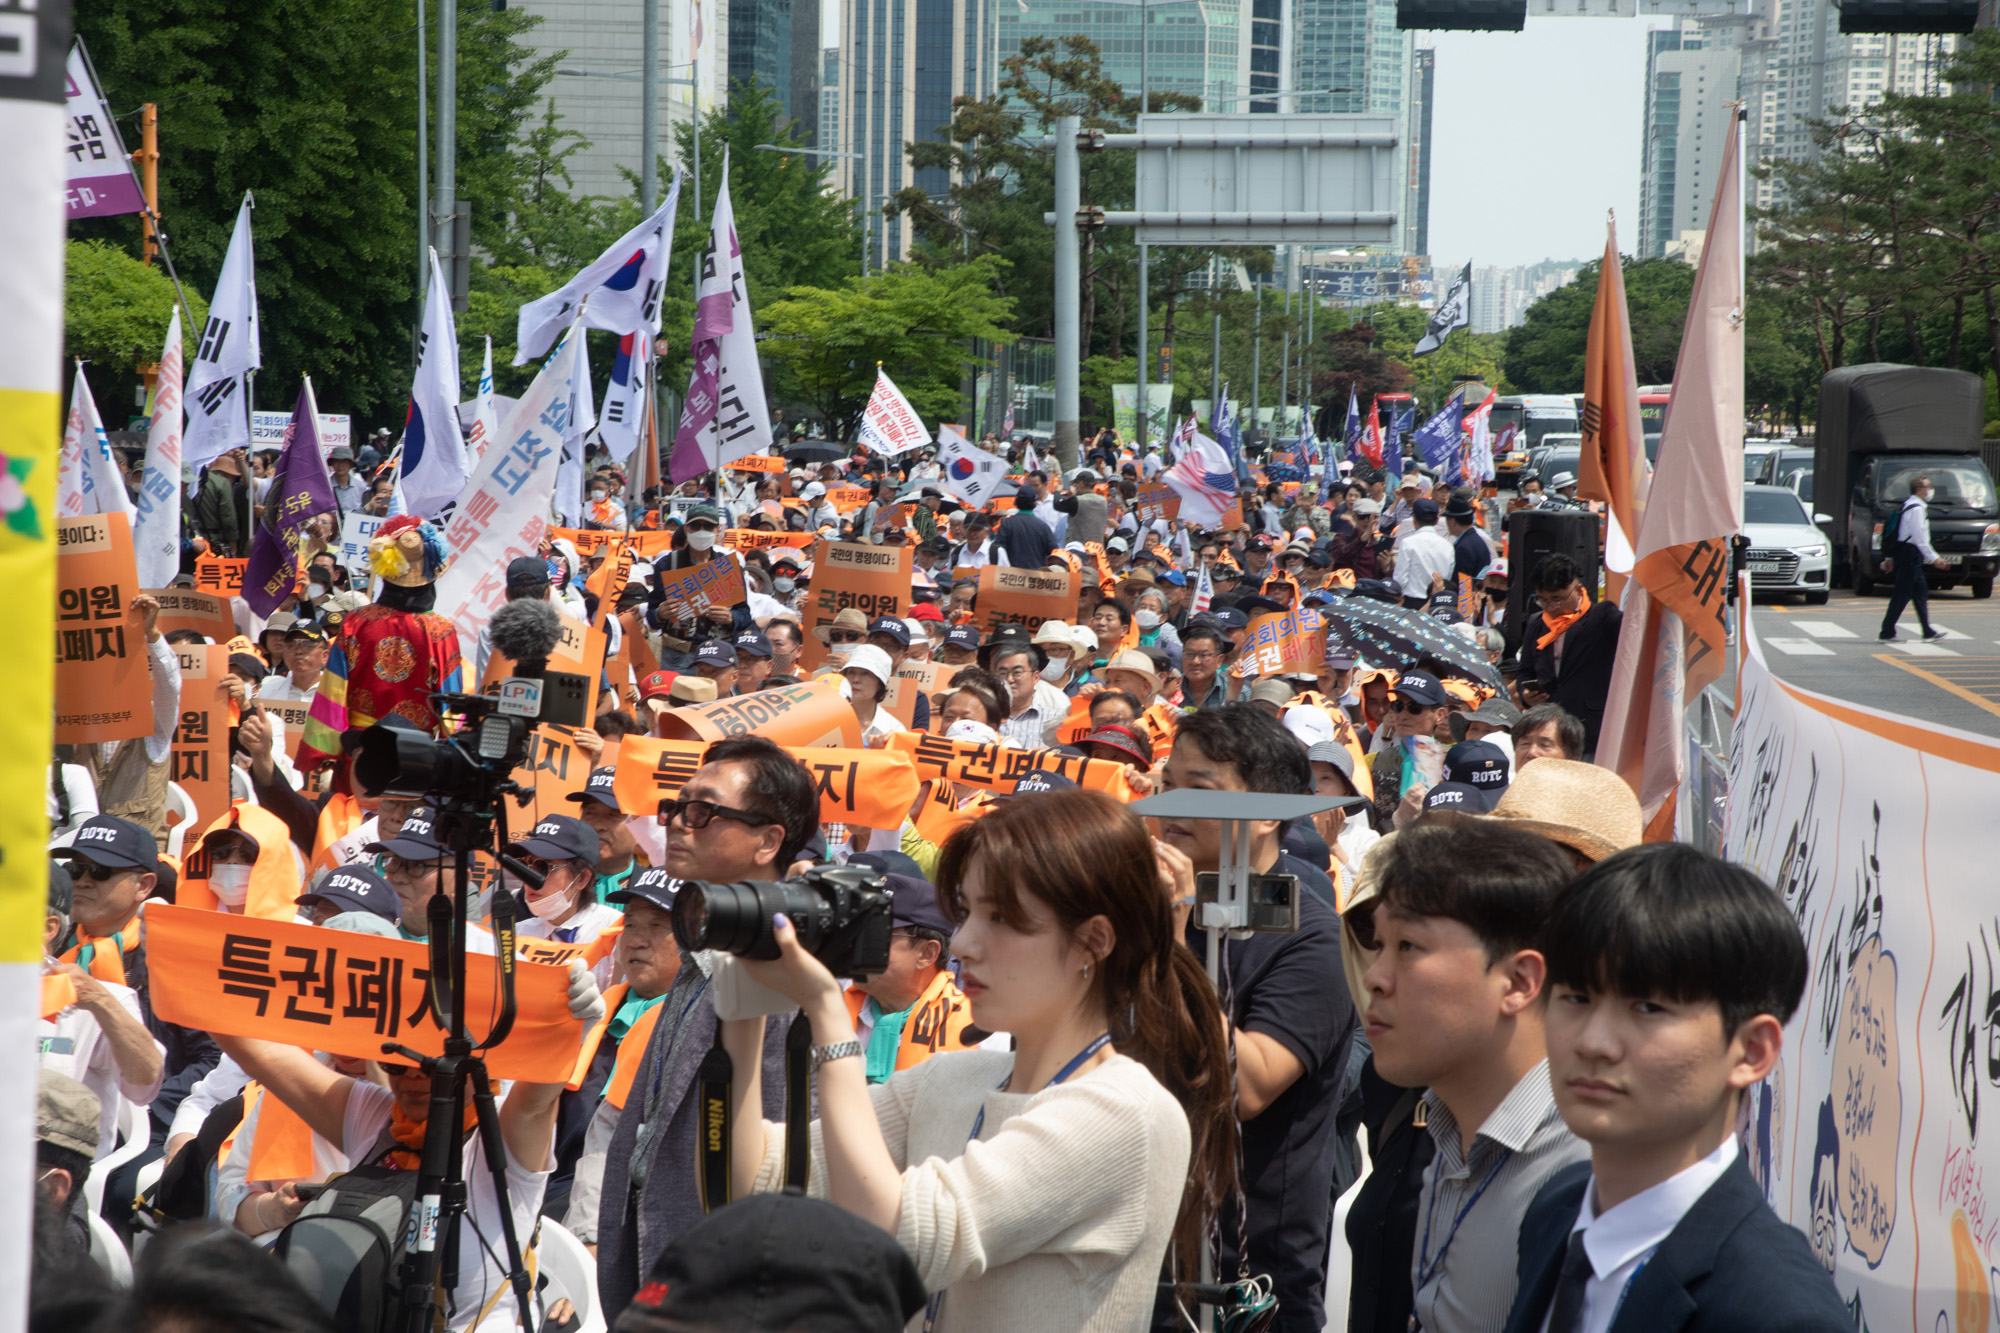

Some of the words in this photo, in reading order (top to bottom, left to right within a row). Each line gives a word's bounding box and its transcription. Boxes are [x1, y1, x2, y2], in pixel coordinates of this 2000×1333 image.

[875, 413, 908, 450] 특권폐지
[731, 456, 768, 469] 권폐지
[835, 491, 871, 502] 특권폐
[724, 531, 790, 549] 특권폐지
[830, 548, 852, 562] 국민의
[664, 556, 735, 602] 국회의원
[999, 573, 1026, 587] 국민의
[56, 584, 122, 621] 의원
[881, 620, 903, 632] ROTC
[1243, 608, 1323, 654] 국회의원
[738, 634, 758, 644] ROTC
[950, 630, 968, 639] ROTC
[1241, 634, 1327, 679] 특권폐지
[1402, 676, 1428, 688] ROTC
[502, 686, 539, 700] LPN
[915, 735, 1090, 791] 특권폐지
[590, 775, 615, 787] ROT
[1471, 769, 1502, 783] ROTC
[1430, 791, 1464, 807] ROTC
[79, 826, 118, 842] ROTC
[329, 874, 371, 896] ROTC
[634, 869, 684, 893] ROTC
[501, 929, 512, 974] Nikon
[707, 1097, 724, 1152] Nikon
